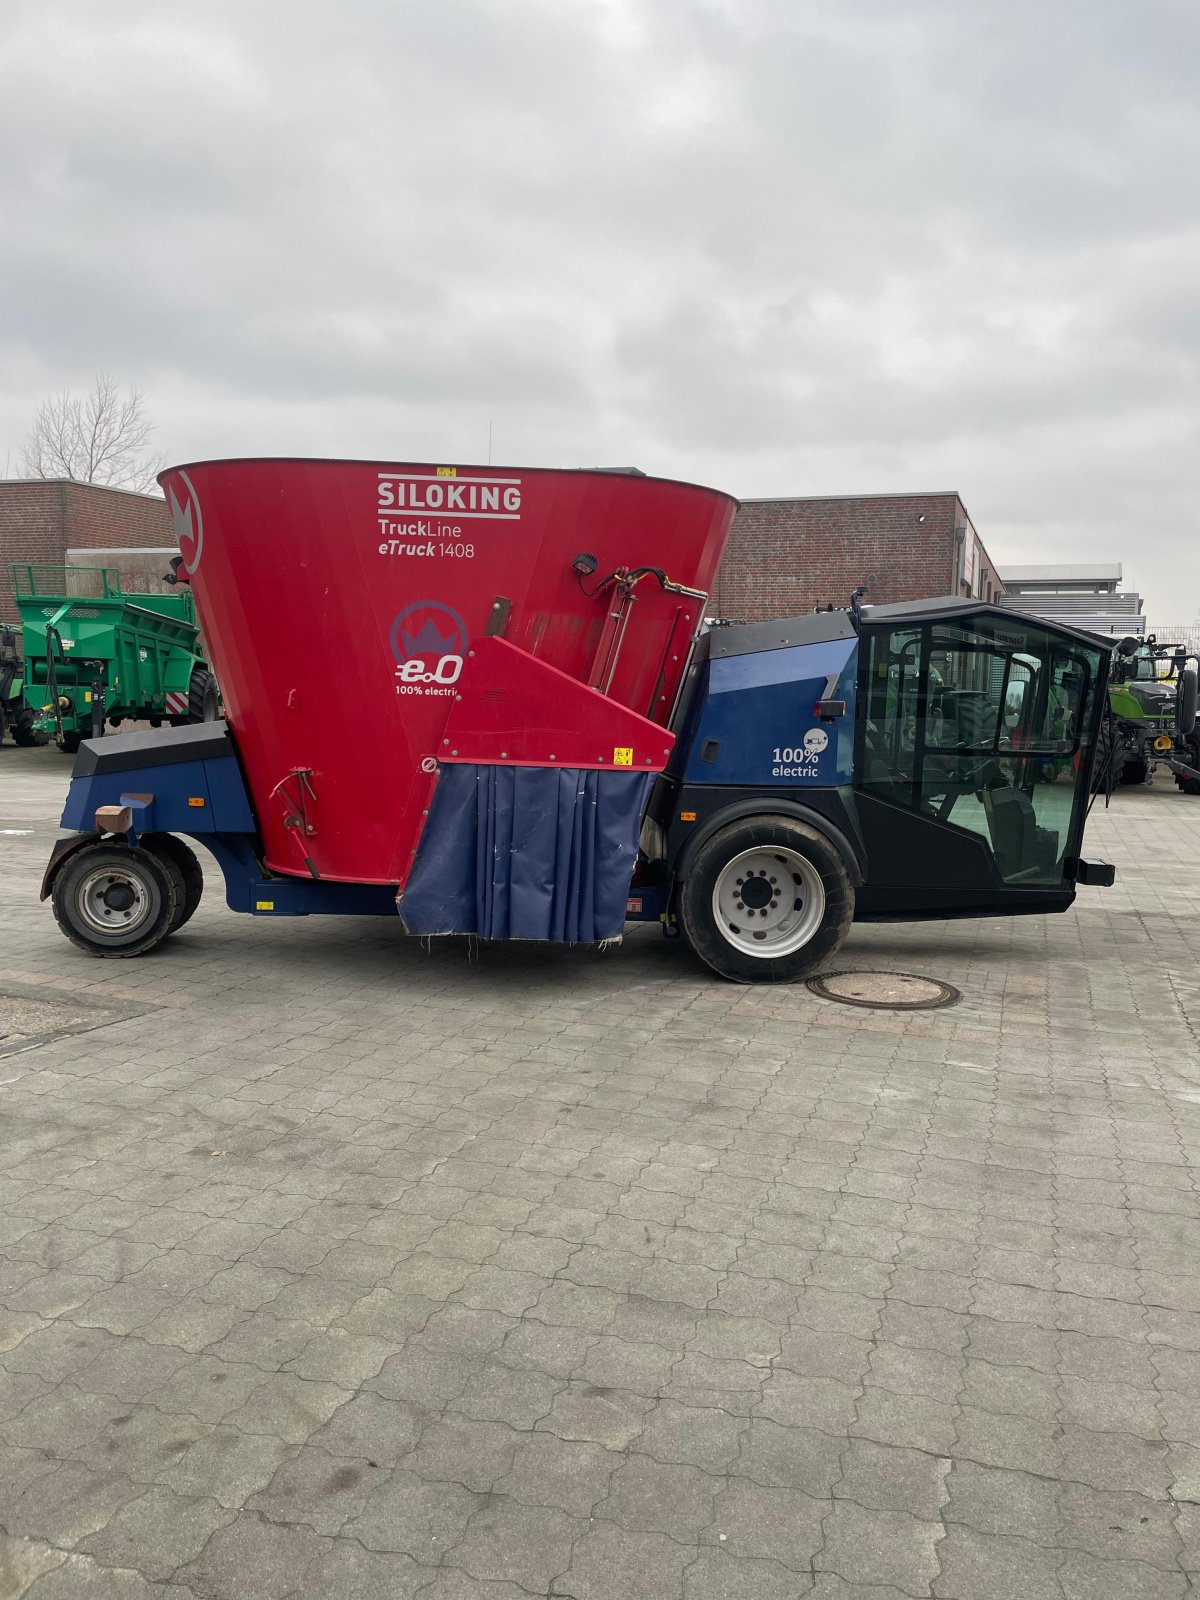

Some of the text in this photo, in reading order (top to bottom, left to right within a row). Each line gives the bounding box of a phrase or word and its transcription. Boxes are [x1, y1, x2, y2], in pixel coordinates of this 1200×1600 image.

[377, 482, 521, 511] SILOKING
[378, 519, 462, 538] TruckLine
[378, 540, 475, 558] eTruck 1408
[395, 686, 423, 695] 100%
[772, 747, 819, 763] 100%
[772, 765, 819, 777] electric
